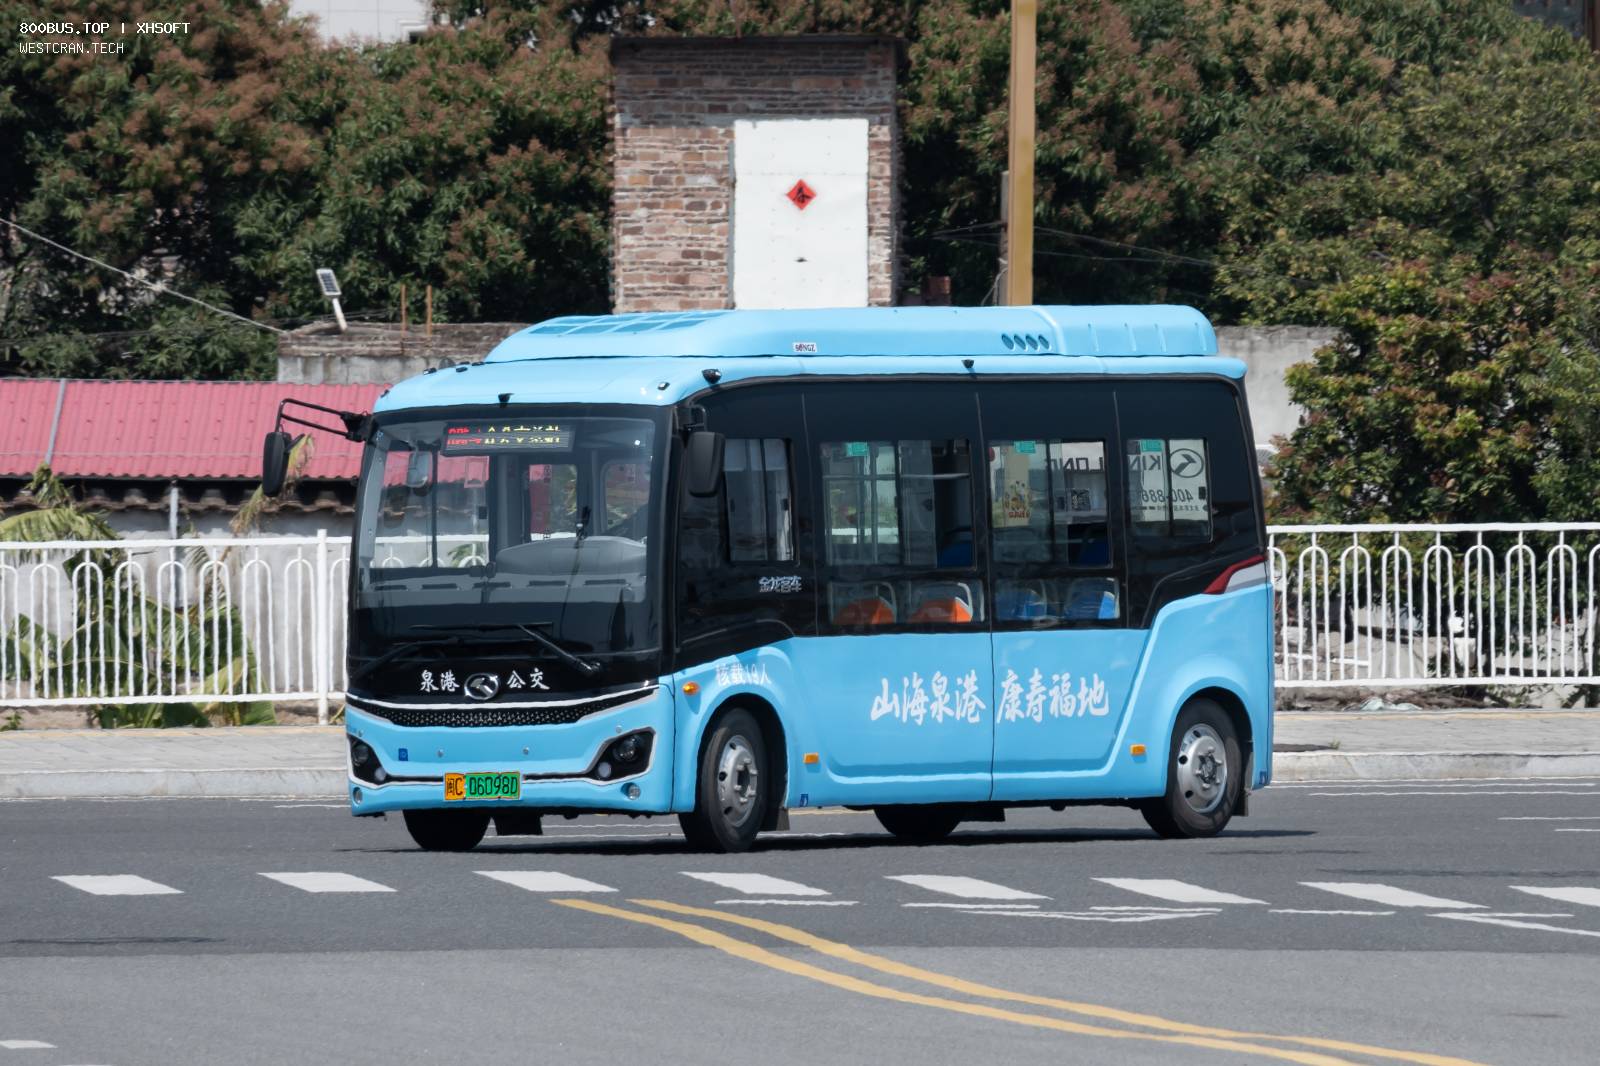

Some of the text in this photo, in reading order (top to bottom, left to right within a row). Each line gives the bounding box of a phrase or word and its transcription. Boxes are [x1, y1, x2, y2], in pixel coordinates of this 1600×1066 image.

[420, 667, 550, 692] 泉港 公交
[870, 667, 1110, 726] 山海泉港 康寿福地
